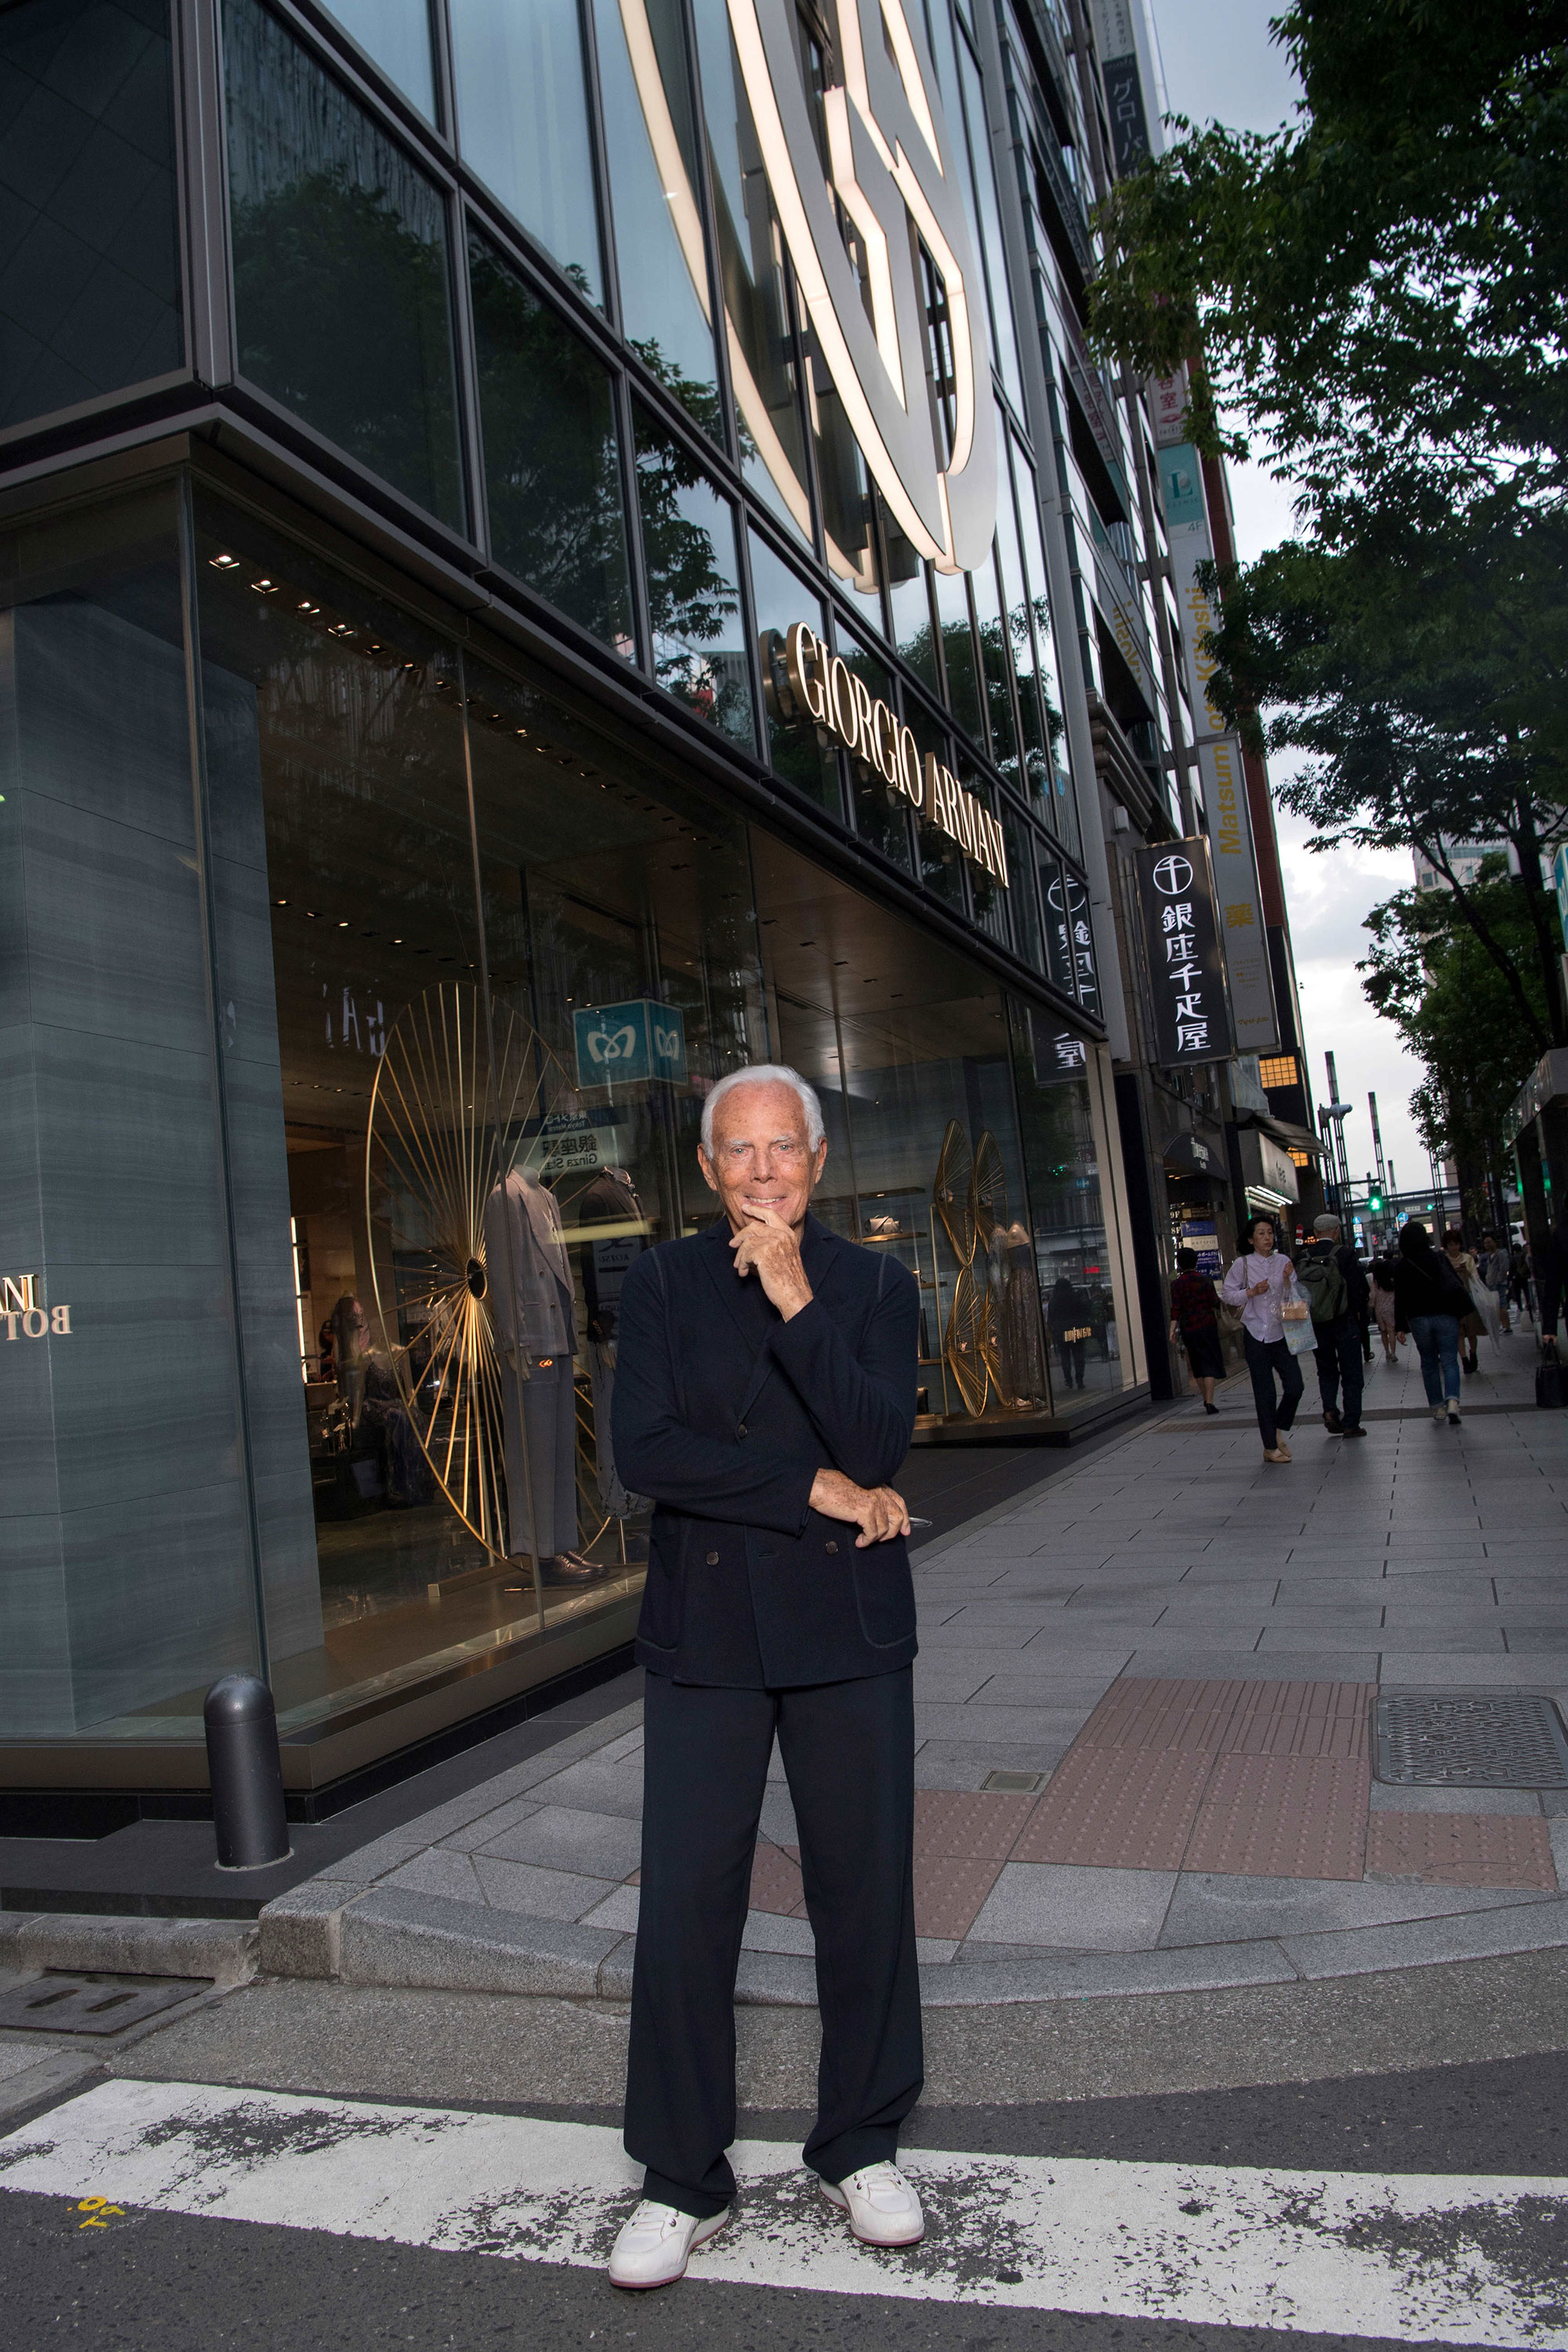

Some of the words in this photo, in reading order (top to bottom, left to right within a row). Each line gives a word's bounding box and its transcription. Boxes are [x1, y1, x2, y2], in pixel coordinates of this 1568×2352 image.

[1113, 78, 1144, 180] グローバ
[1187, 521, 1203, 532] 4F
[788, 621, 923, 808] GIORGIO
[927, 751, 1010, 888] ARMANI
[1160, 902, 1211, 1053] 銀座千疋屋
